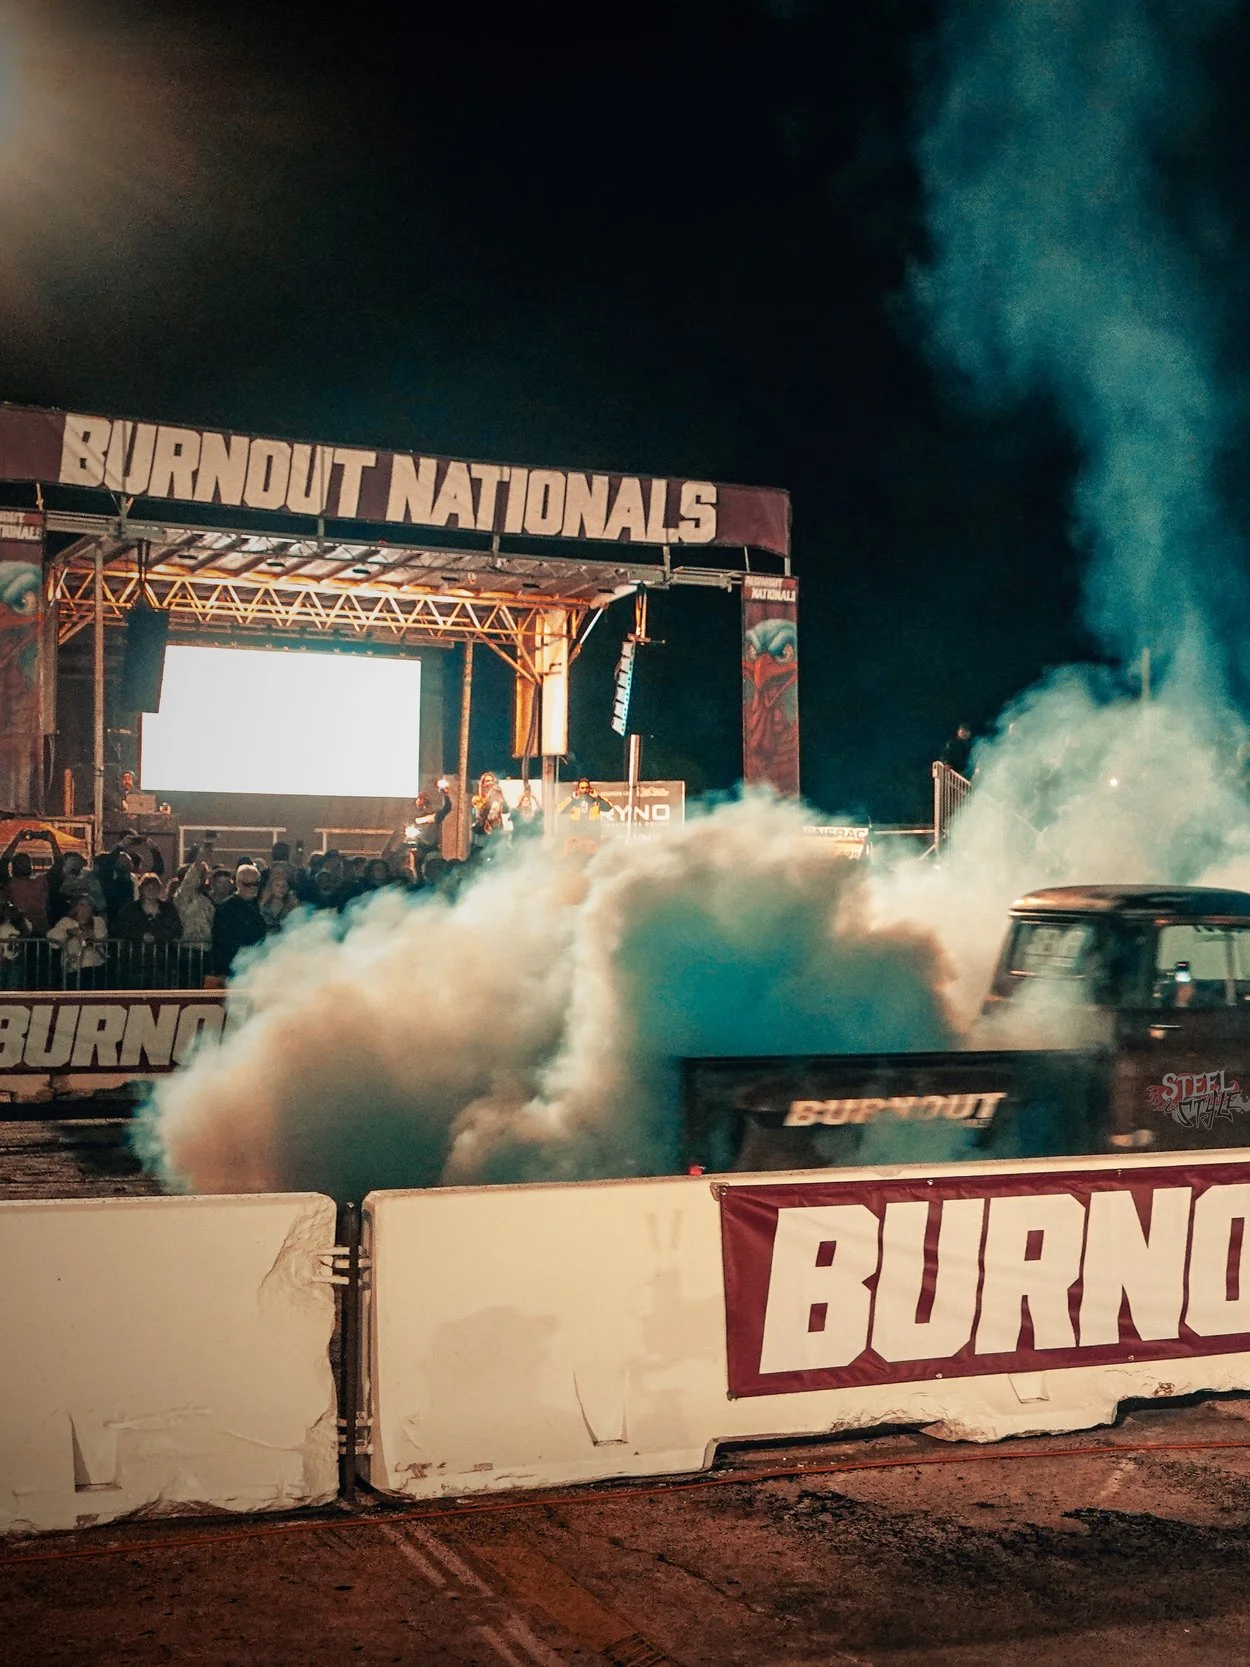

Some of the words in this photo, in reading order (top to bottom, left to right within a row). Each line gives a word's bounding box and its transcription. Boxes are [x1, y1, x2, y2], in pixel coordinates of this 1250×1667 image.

[59, 413, 376, 518] BURNOUT
[385, 454, 717, 544] NATIONALS
[1161, 1069, 1239, 1101] STEEL
[1178, 1089, 1243, 1131] STYLE
